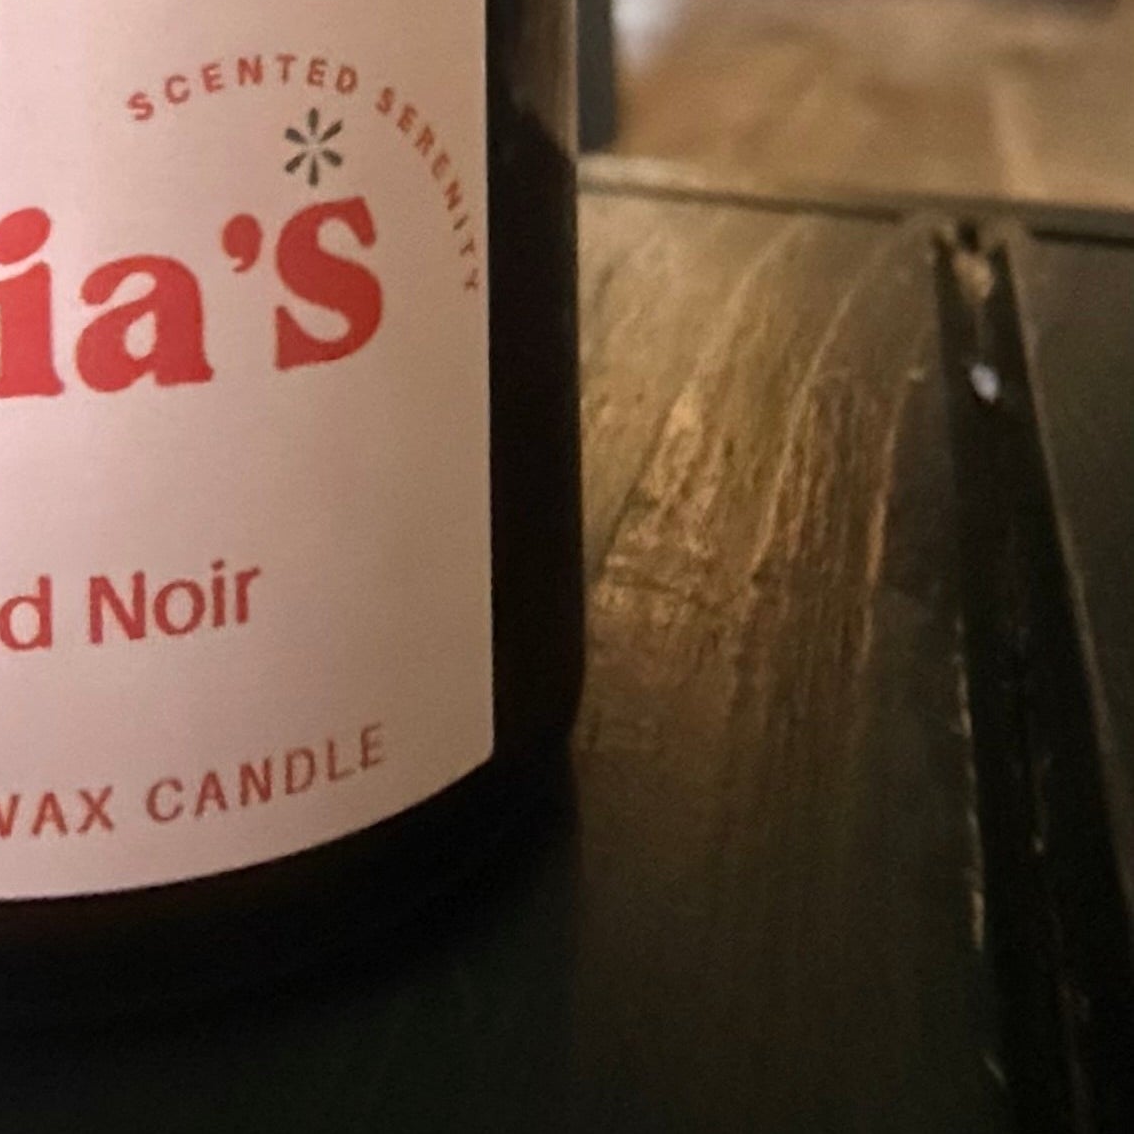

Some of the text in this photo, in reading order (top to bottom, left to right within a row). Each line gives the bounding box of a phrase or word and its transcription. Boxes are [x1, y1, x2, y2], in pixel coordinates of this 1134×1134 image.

[125, 53, 480, 291] SCENTED SERENITY
[88, 559, 262, 646] Noir
[145, 723, 387, 824] CANDLE
